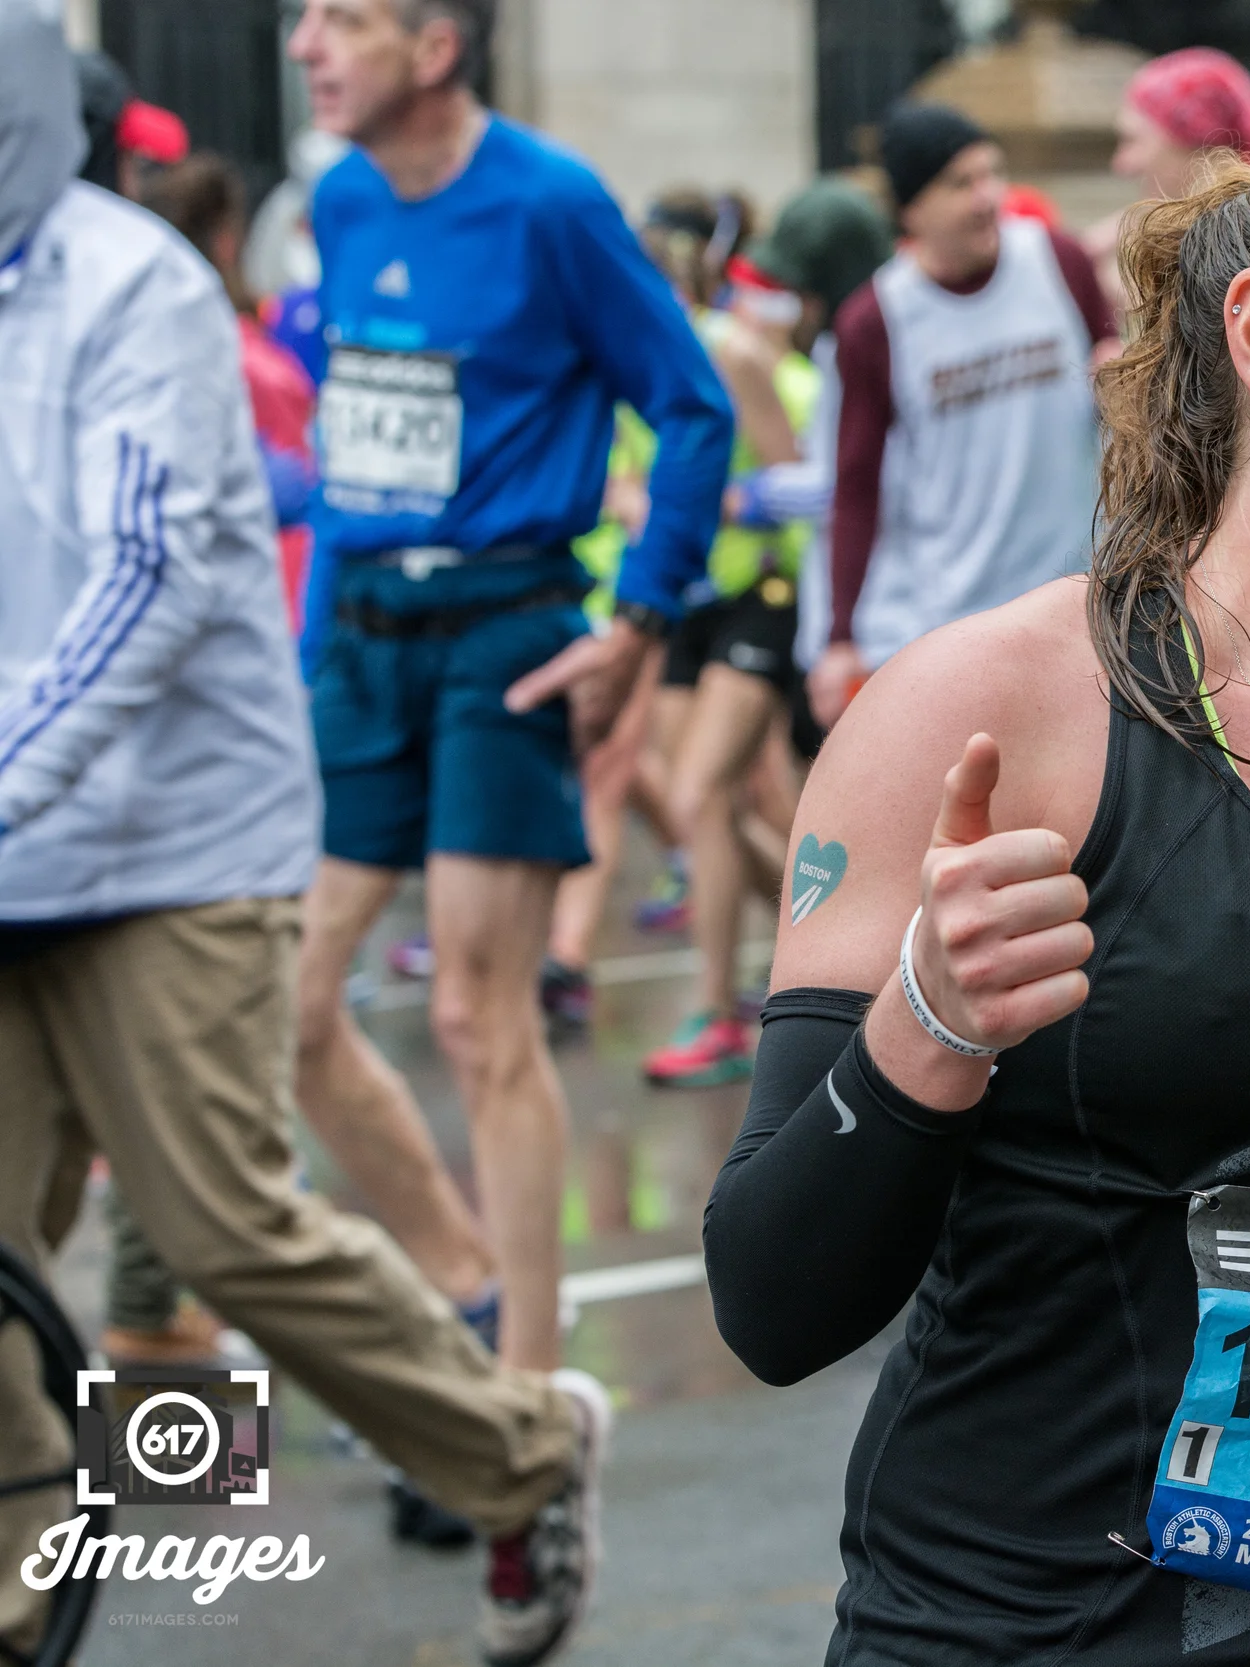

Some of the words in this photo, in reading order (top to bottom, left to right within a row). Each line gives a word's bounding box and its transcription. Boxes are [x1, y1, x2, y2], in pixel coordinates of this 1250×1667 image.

[799, 861, 831, 882] BOSTON
[933, 1029, 982, 1056] ONLY
[1182, 1427, 1211, 1479] 1
[1165, 1521, 1179, 1545] BOSTON
[1177, 1509, 1212, 1523] ATHLETIC
[1211, 1514, 1229, 1555] ASSOCIATION
